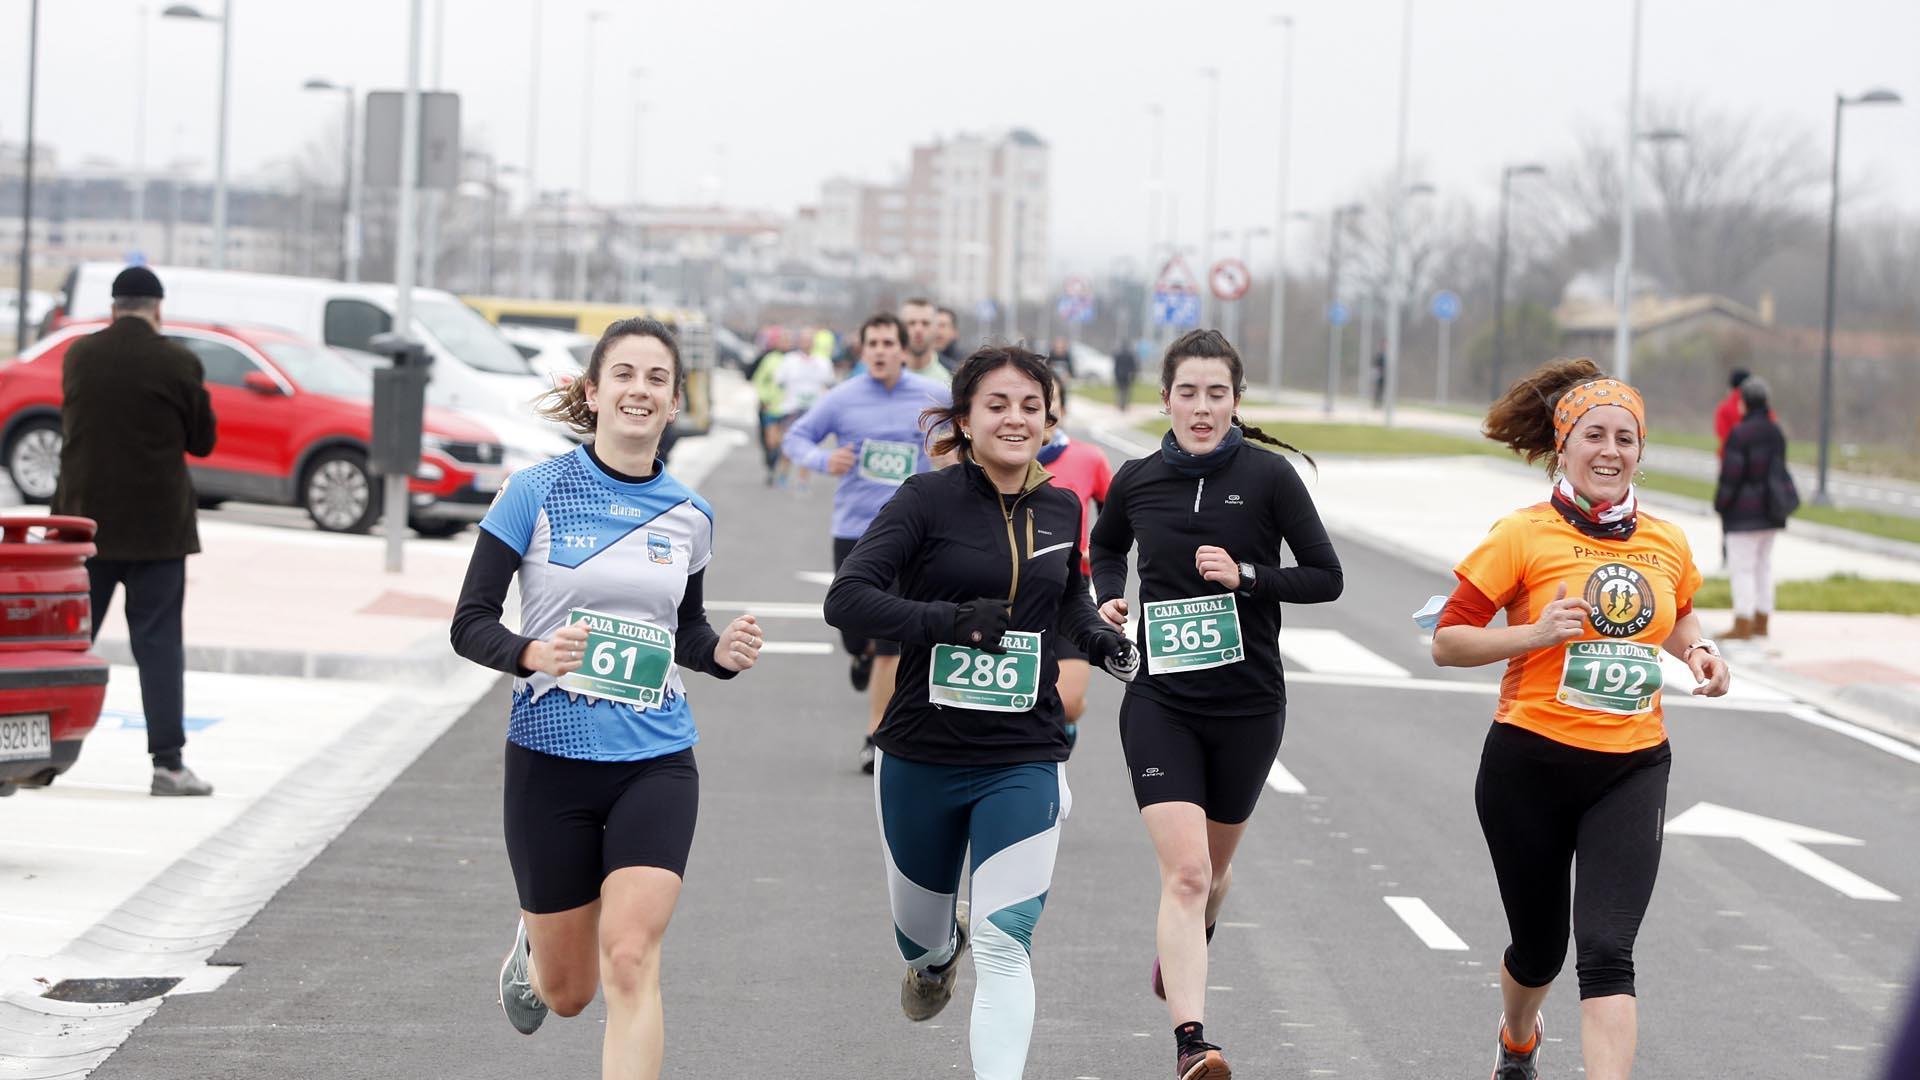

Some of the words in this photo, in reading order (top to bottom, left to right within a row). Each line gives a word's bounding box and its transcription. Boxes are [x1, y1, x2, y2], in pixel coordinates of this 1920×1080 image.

[868, 452, 907, 475] 600
[564, 535, 598, 548] TXT
[1597, 566, 1639, 583] BEER
[1154, 604, 1182, 618] CAJA
[1183, 600, 1227, 615] RURAL
[1590, 606, 1653, 636] RUNNERS
[617, 622, 666, 645] RURAL
[998, 636, 1032, 651] RAL
[1161, 619, 1222, 653] 365
[591, 641, 638, 681] 61
[1578, 643, 1613, 656] CAJA
[946, 651, 1018, 689] 286
[1584, 660, 1648, 695] 192
[0, 721, 29, 749] 928
[32, 719, 49, 748] CH
